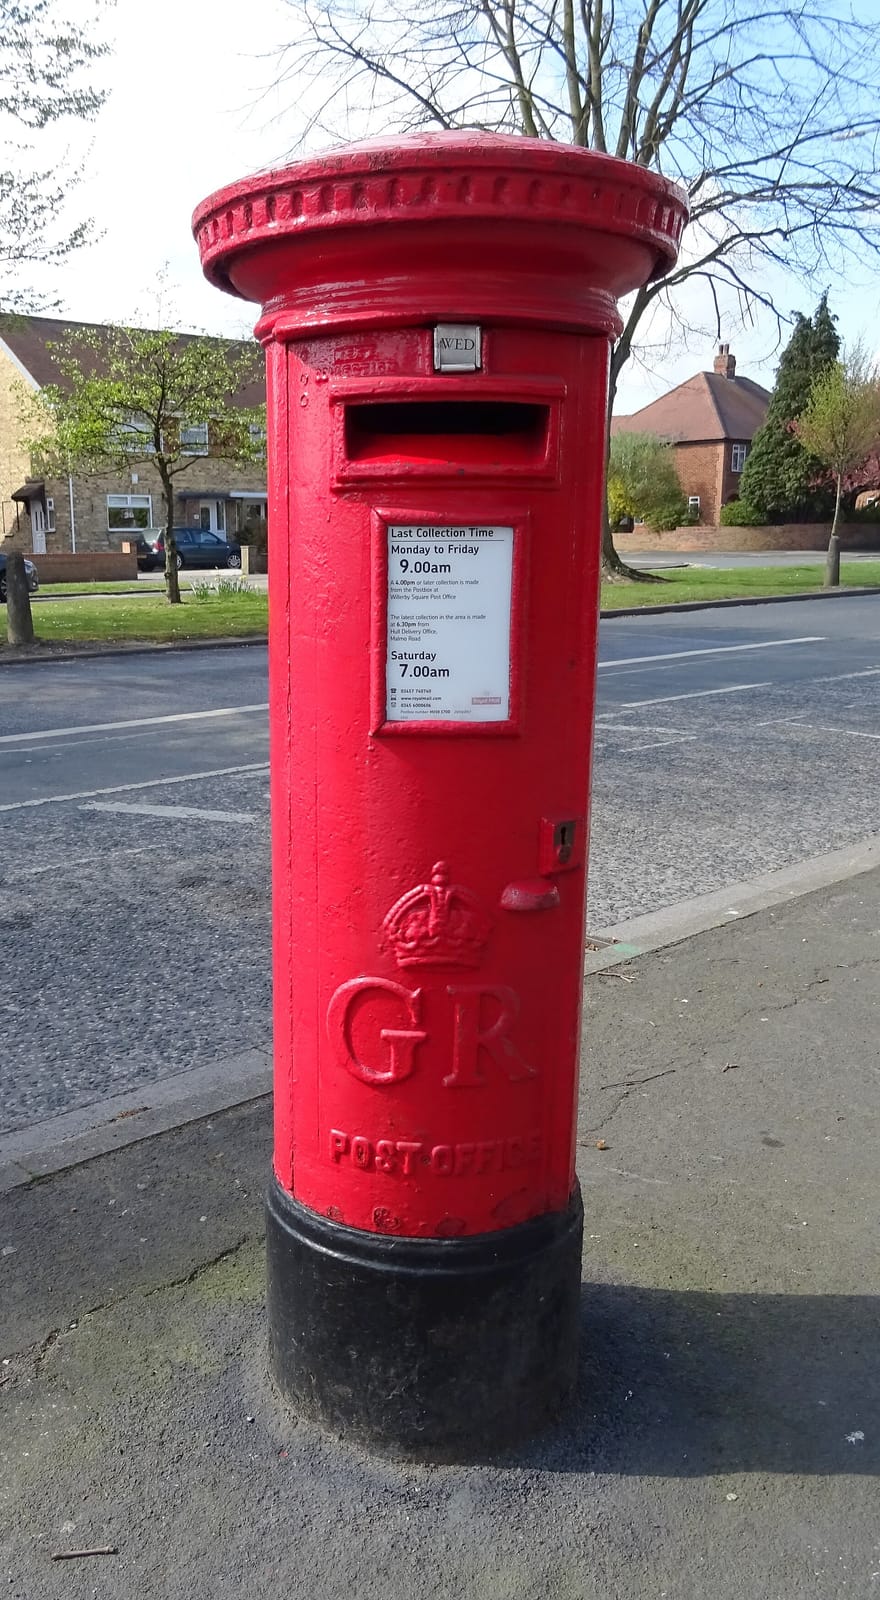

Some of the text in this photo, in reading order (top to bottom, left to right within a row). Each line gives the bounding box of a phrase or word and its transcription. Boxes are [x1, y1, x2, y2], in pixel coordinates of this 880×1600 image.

[440, 337, 474, 350] WED
[391, 528, 494, 538] Last Collection Time
[391, 544, 480, 556] Monday to Friday
[400, 559, 451, 574] 9.00am
[391, 651, 437, 662] Saturday
[399, 664, 450, 678] 7.00am
[330, 1128, 424, 1174] POST
